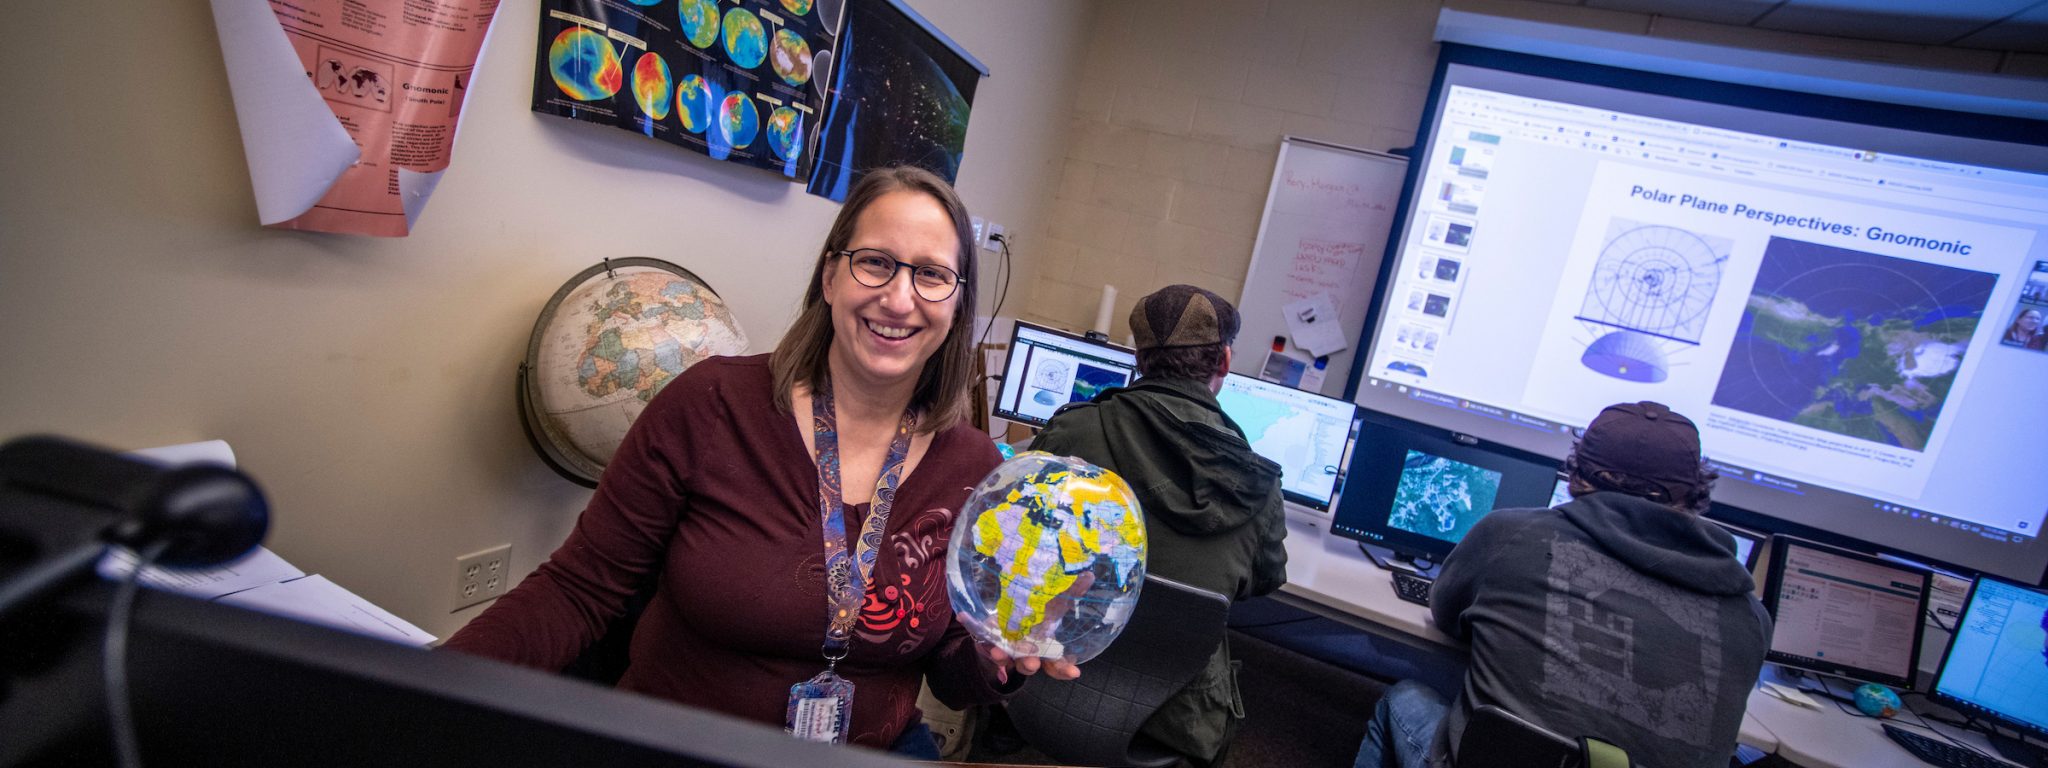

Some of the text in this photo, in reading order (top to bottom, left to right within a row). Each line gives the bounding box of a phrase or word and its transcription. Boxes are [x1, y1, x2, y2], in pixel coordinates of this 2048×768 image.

[402, 82, 449, 95] Gnomonic
[1630, 184, 1974, 256] Polar Plane Perspectives: Gnomonic
